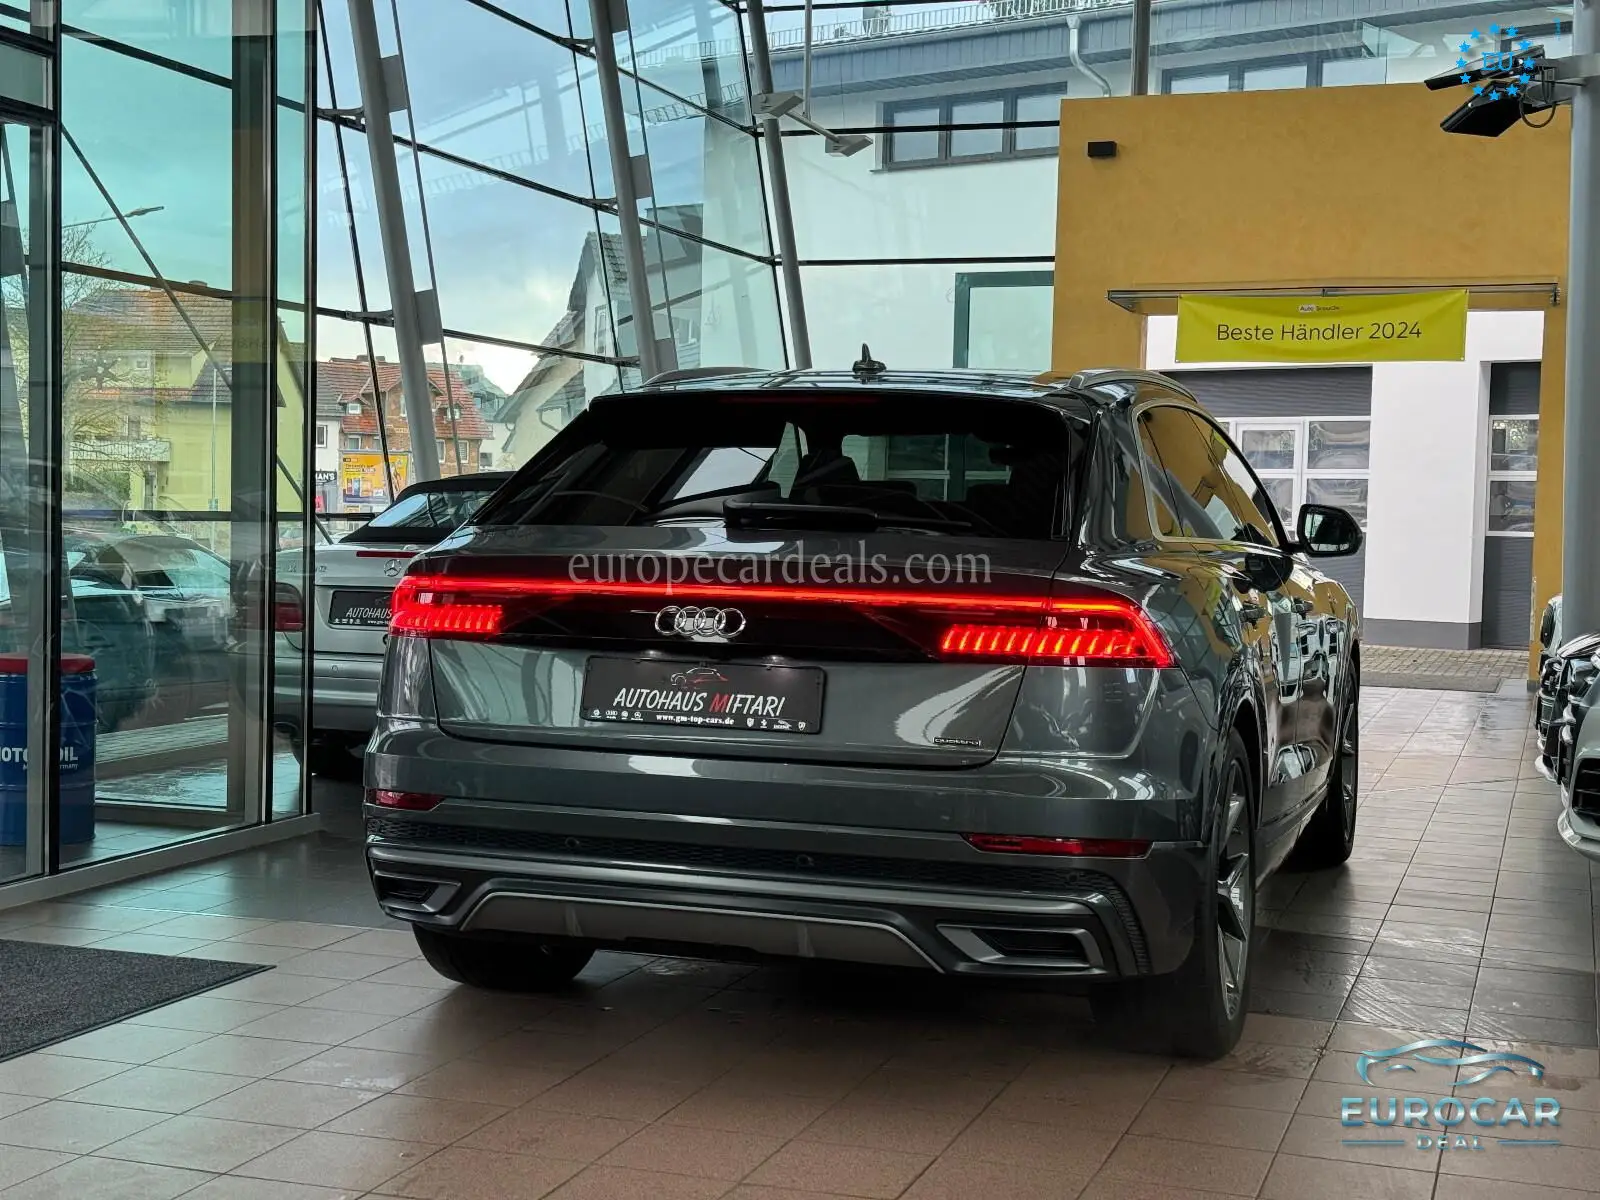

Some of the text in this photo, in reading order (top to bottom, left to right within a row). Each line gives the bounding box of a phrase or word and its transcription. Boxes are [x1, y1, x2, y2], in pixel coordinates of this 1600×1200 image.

[1217, 321, 1422, 341] Beste Händler 2024
[316, 472, 336, 481] AN'S
[346, 607, 393, 620] AUTOHAUS
[612, 687, 786, 717] AUTOHAUS MIFTARI
[656, 714, 735, 725] www.gm-top-cars.de
